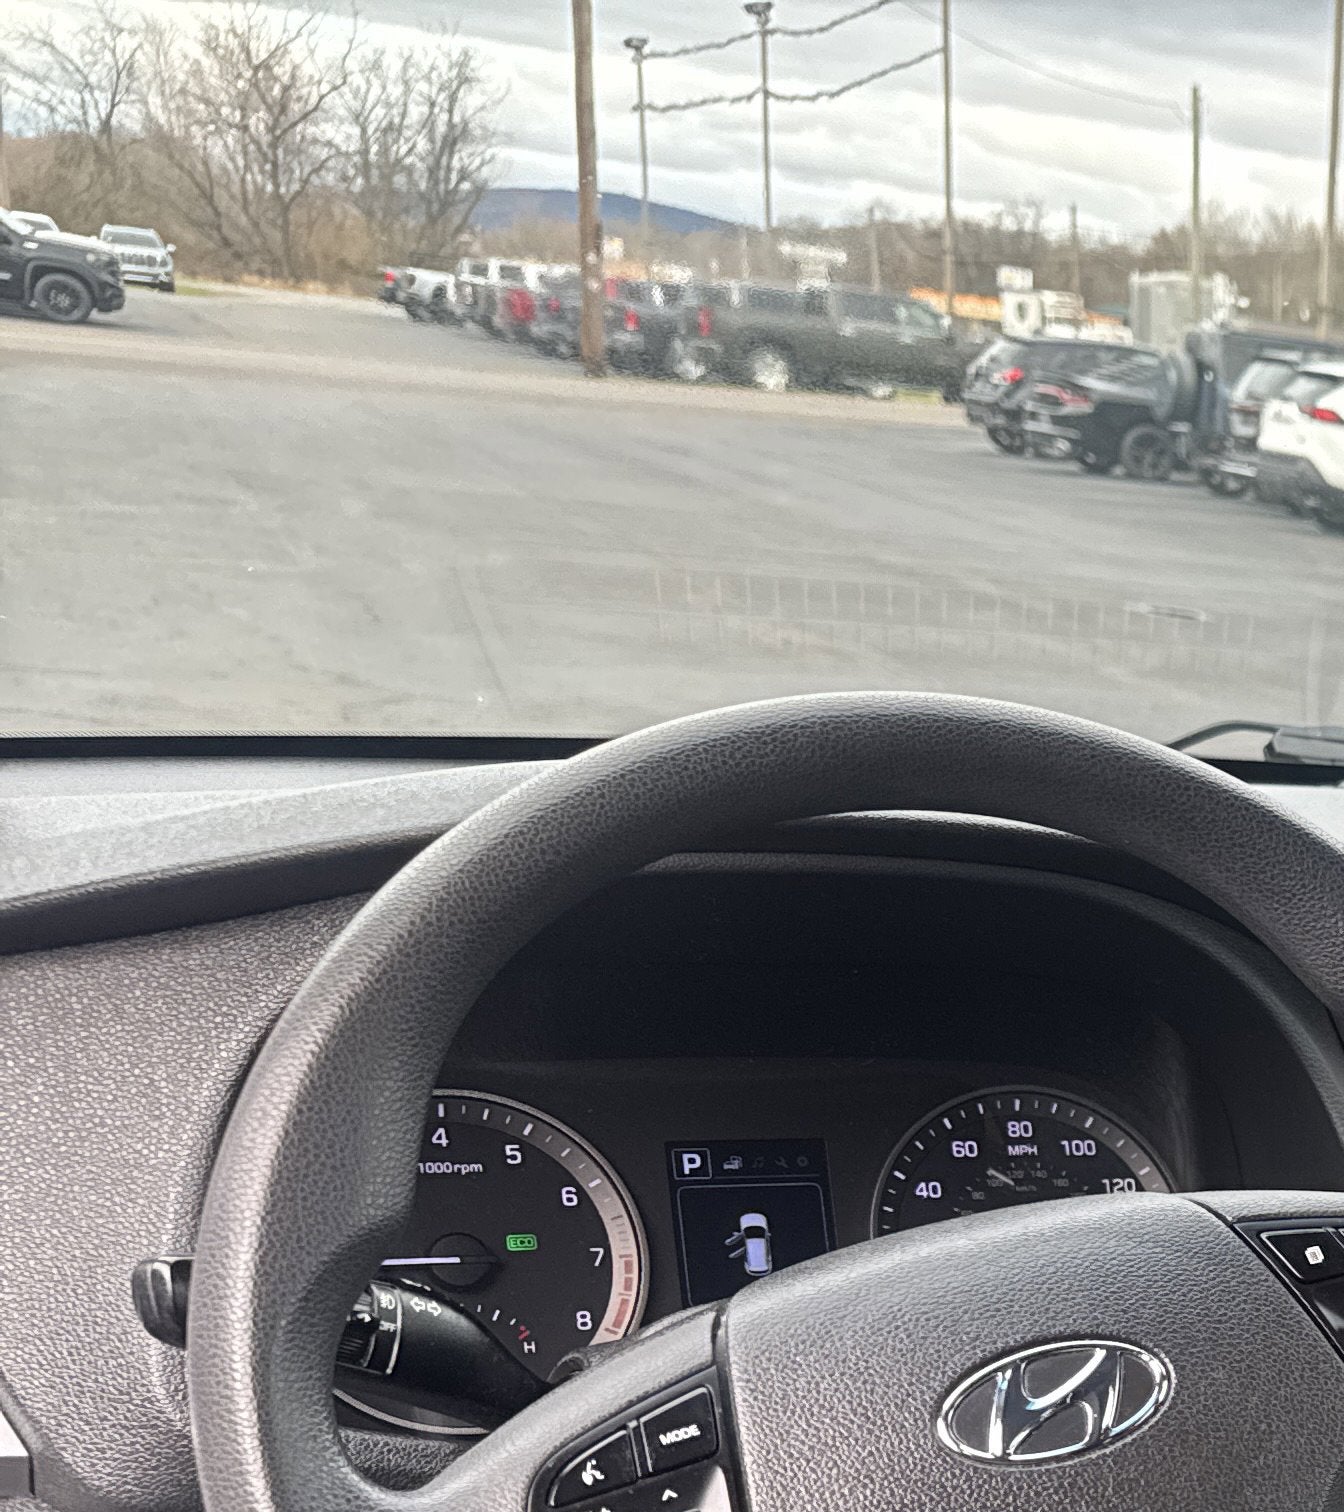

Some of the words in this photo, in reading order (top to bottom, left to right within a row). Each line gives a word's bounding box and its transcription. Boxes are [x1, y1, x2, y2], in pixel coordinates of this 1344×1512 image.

[431, 1127, 449, 1148] 4
[1007, 1121, 1033, 1138] 80
[504, 1144, 522, 1165] 5
[952, 1141, 978, 1158] 60
[1007, 1144, 1038, 1156] MPH
[1060, 1139, 1096, 1157] 100
[682, 1153, 701, 1175] P
[915, 1181, 942, 1199] 40
[1102, 1178, 1136, 1194] 120
[561, 1187, 578, 1206] 6
[511, 1237, 535, 1248] ECO
[589, 1247, 604, 1267] 7
[576, 1311, 592, 1330] 8
[524, 1341, 536, 1354] H
[658, 1424, 701, 1446] MODE
